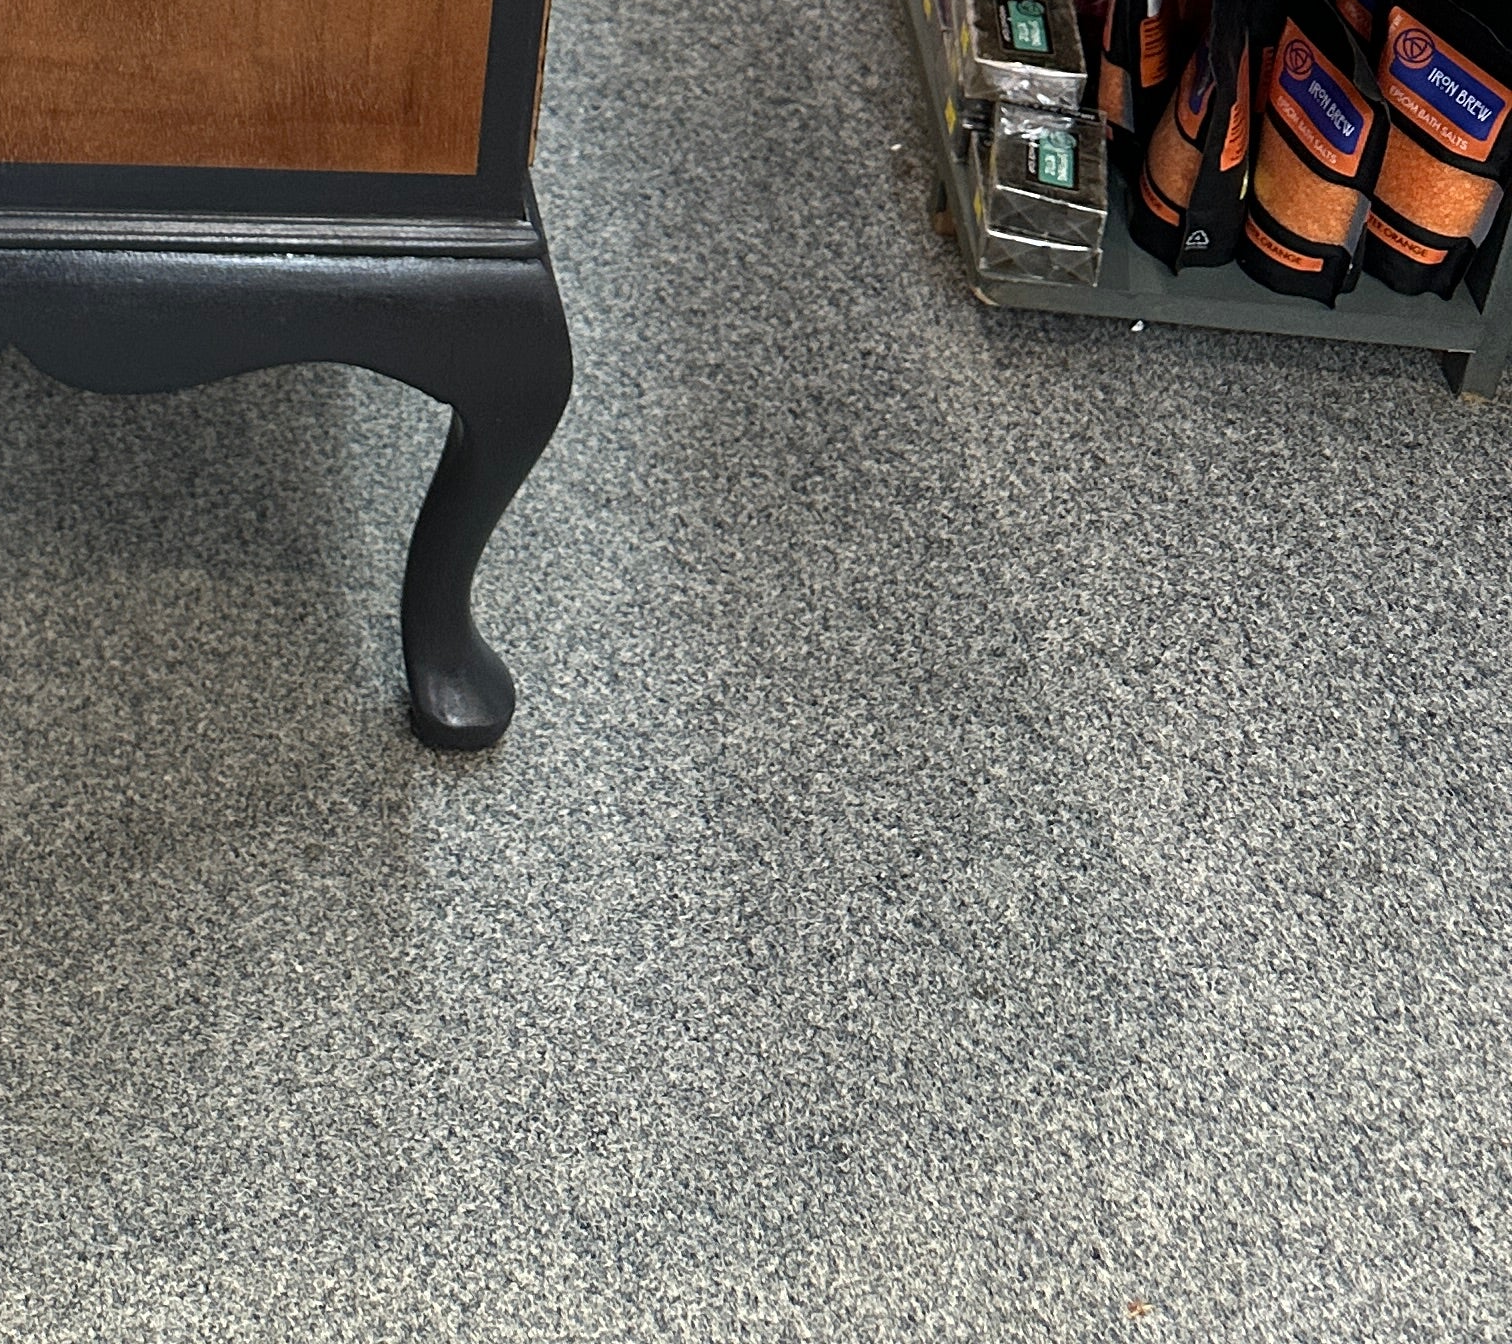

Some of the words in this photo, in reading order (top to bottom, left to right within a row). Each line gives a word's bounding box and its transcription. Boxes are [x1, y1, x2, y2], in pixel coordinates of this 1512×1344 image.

[1308, 79, 1330, 109] IRON
[1326, 101, 1356, 137] BREW
[1388, 84, 1419, 113] EPSOM
[1416, 106, 1441, 133] BATH
[1438, 123, 1469, 151] SALTS
[1427, 67, 1458, 98] IRON
[1455, 89, 1493, 122] BREW
[1297, 120, 1316, 145] BATH
[1313, 136, 1338, 164] SALTS
[1260, 234, 1303, 266] ORANGE
[1384, 226, 1428, 259] ORANGE
